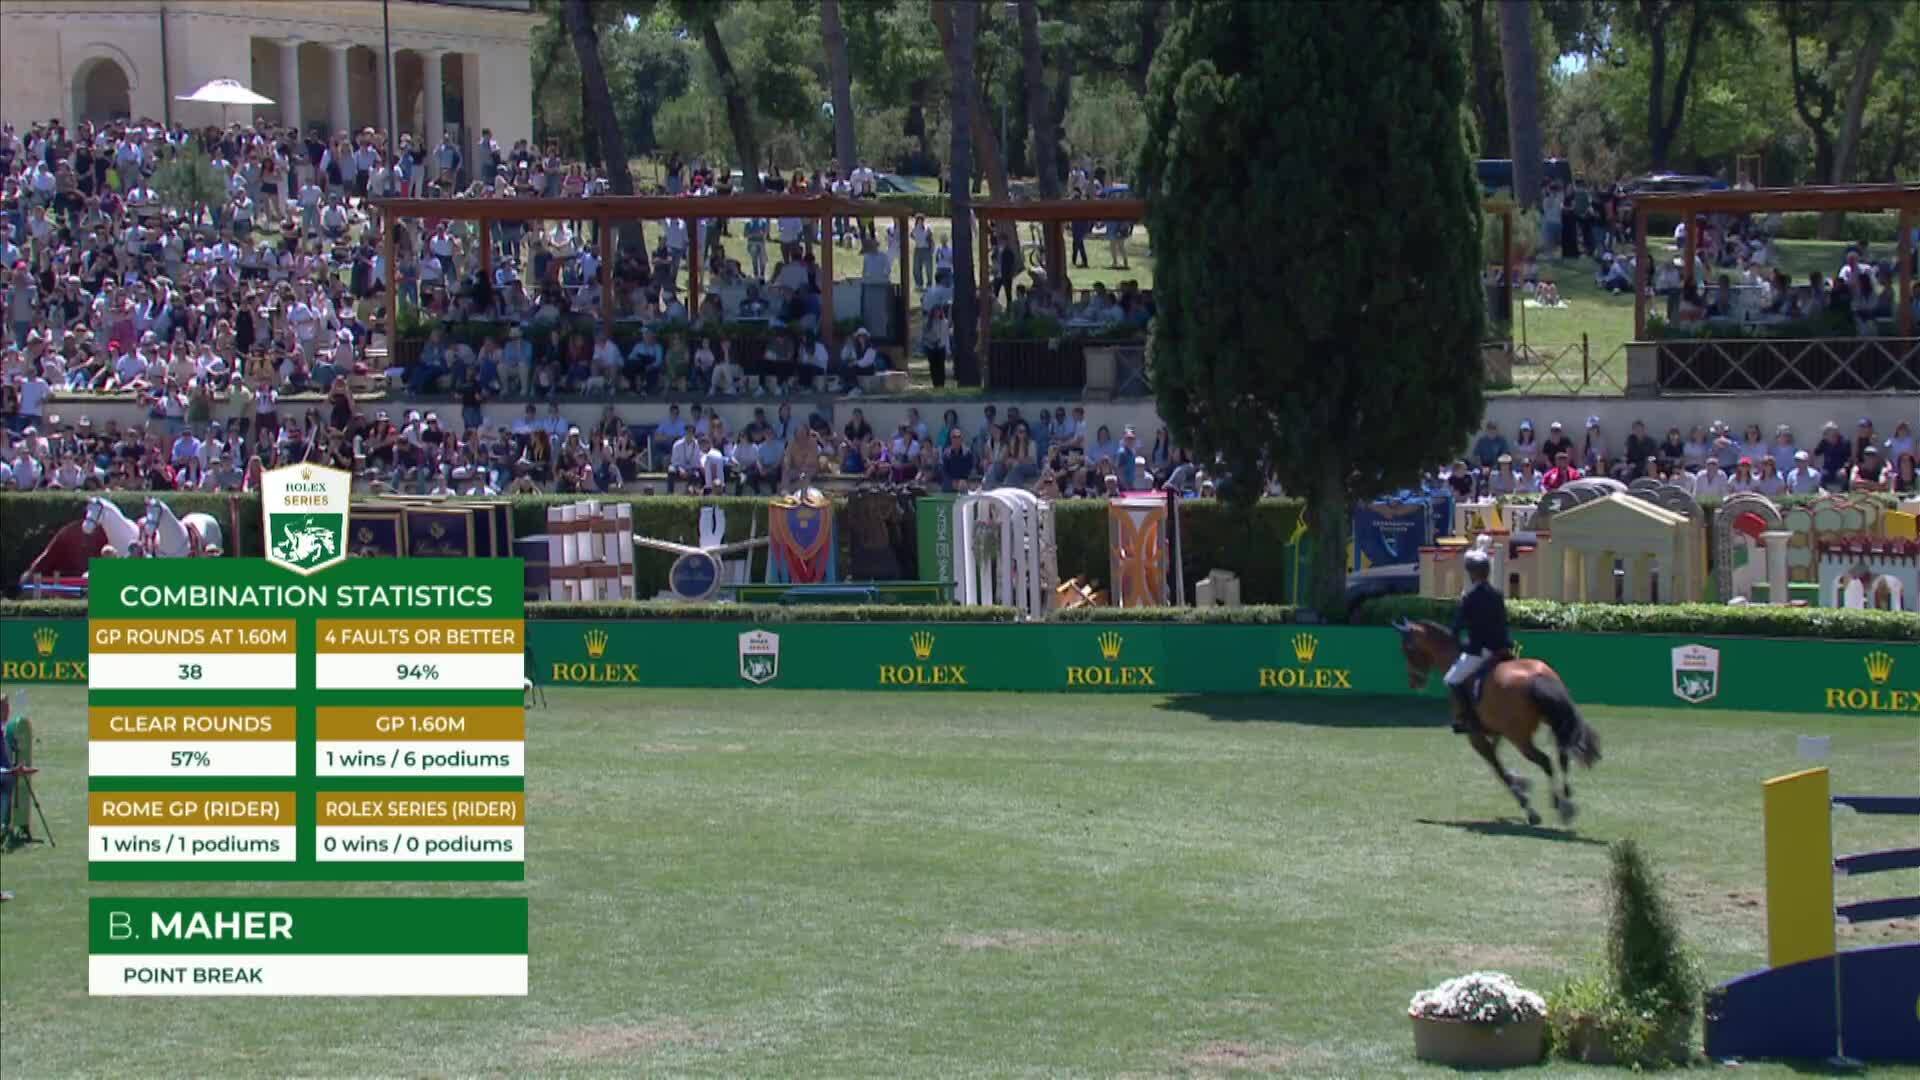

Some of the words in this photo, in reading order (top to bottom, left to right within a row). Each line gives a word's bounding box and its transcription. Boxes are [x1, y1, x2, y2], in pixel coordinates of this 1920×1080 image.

[2, 662, 87, 680] ROLEX
[552, 663, 639, 682] ROLEX
[878, 665, 966, 685] ROLEX
[1067, 666, 1155, 686] ROLEX
[1259, 669, 1351, 689] ROLEX
